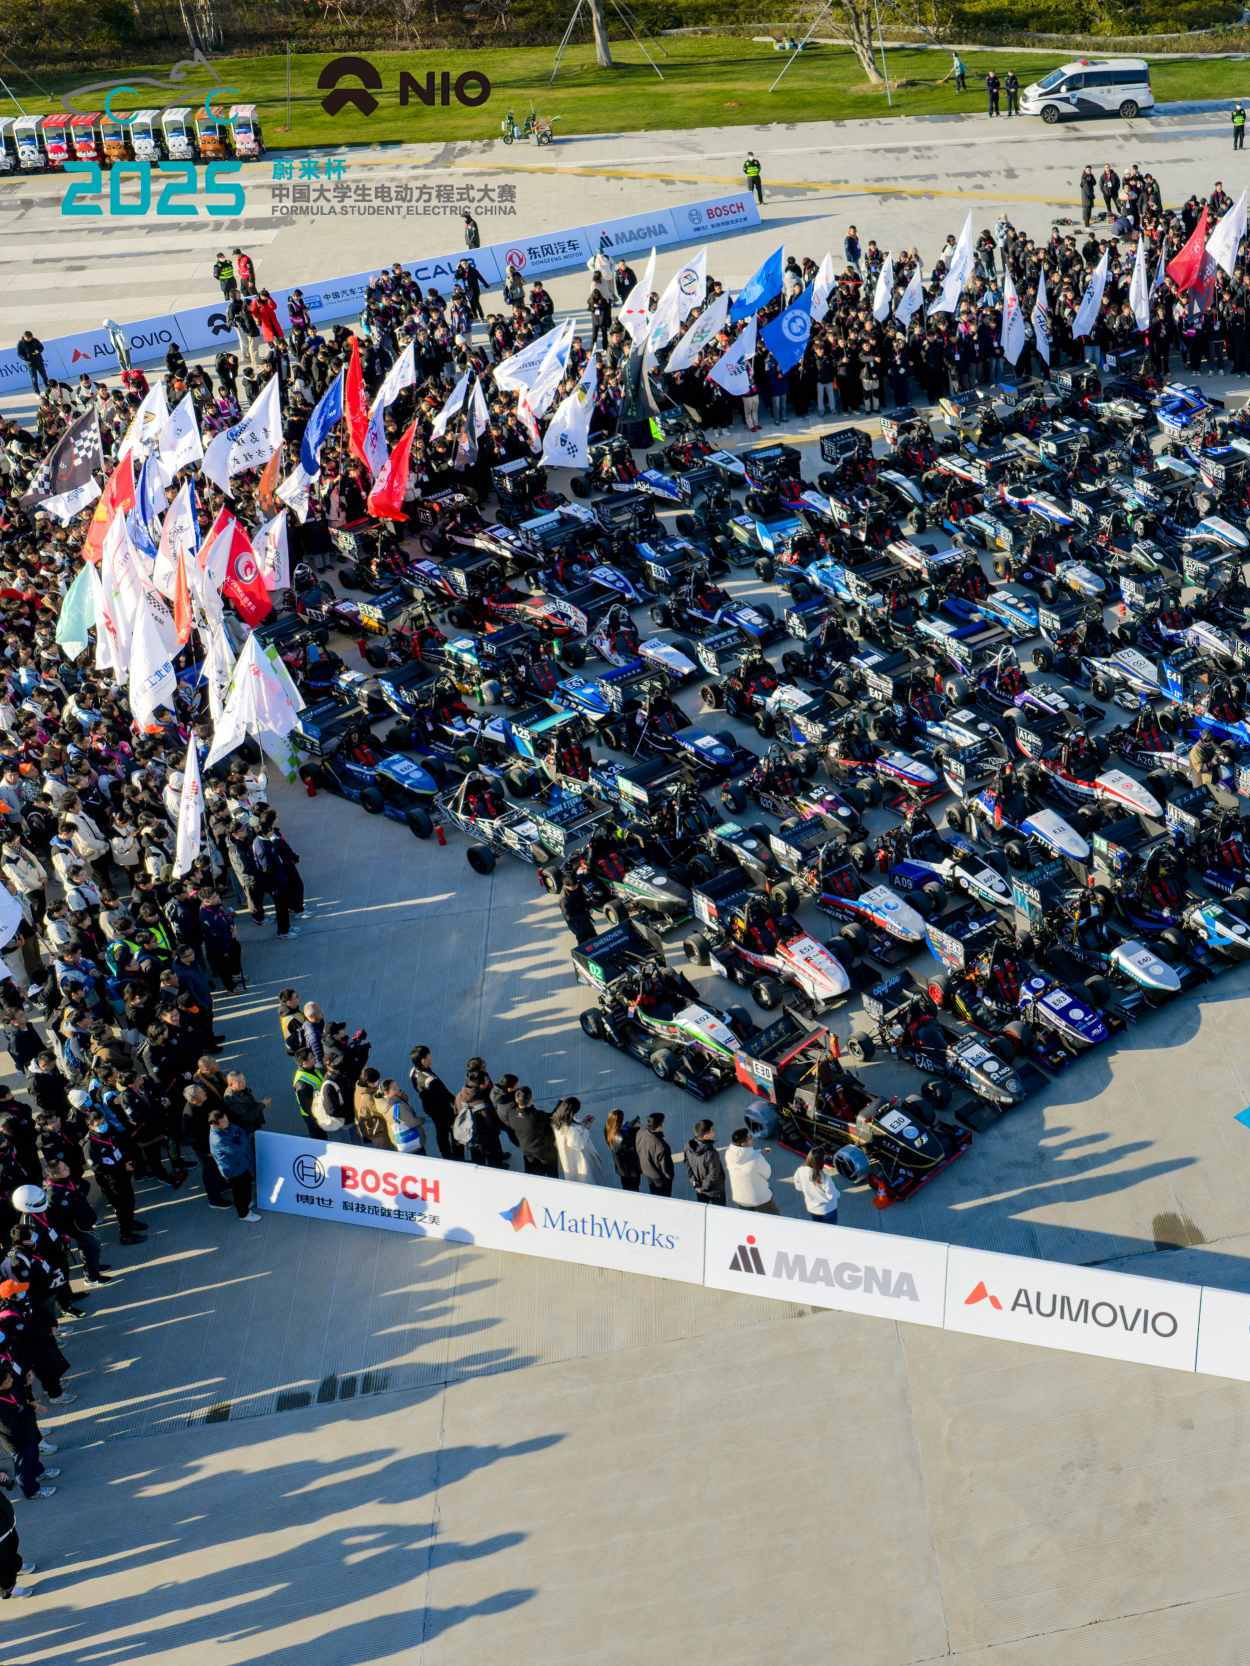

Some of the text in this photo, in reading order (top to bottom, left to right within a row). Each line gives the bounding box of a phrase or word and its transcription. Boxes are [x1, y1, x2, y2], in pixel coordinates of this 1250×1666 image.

[706, 202, 745, 220] BOSCH
[614, 224, 669, 245] MAGNA
[527, 239, 580, 260] 东风汽车
[93, 330, 173, 358] AUOVIO
[894, 877, 912, 889] A09
[1023, 884, 1040, 899] E40
[589, 962, 602, 978] 02
[695, 1015, 709, 1025] E02
[890, 1115, 907, 1132] E30
[340, 1165, 440, 1203] BOSCH
[295, 1193, 334, 1209] 博世
[541, 1206, 673, 1252] MathWorks
[771, 1249, 920, 1303] MAGNA
[1010, 1286, 1179, 1338] AUMOVIO
